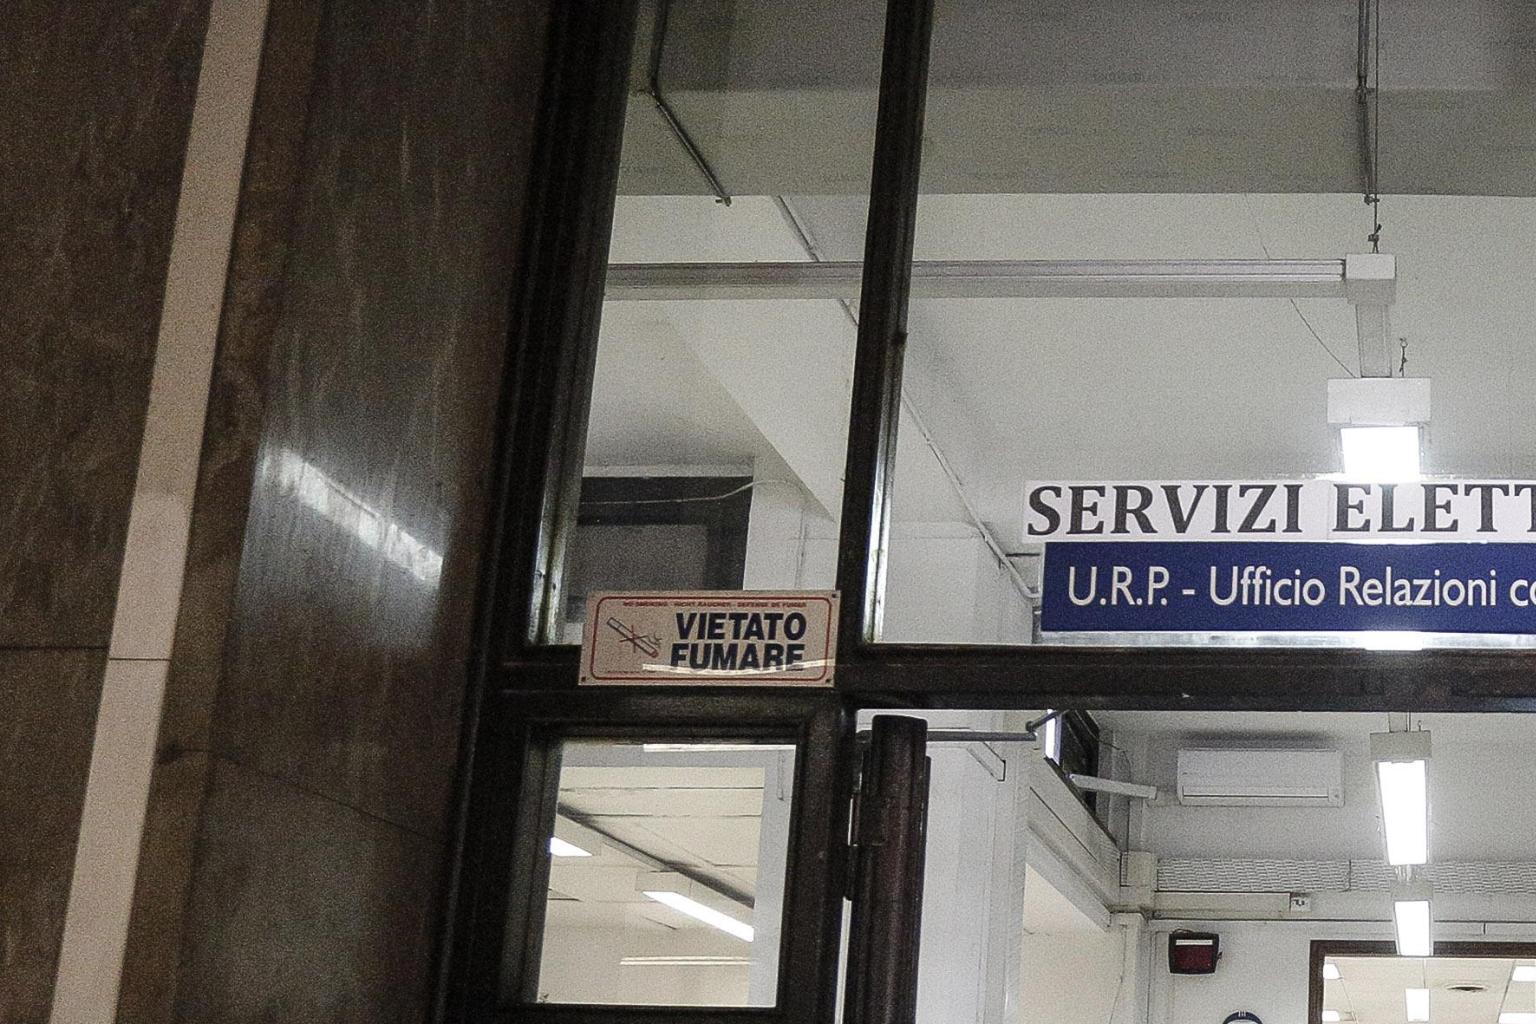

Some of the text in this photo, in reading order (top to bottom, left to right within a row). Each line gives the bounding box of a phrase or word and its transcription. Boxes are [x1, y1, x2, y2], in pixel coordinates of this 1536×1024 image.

[1027, 484, 1304, 536] SERVIZI
[1068, 566, 1169, 606] U.R.P.
[1210, 565, 1326, 606] Ufficio
[1339, 565, 1497, 607] Relazioni
[676, 612, 807, 641] VIETATO
[670, 643, 806, 671] FUMARE
